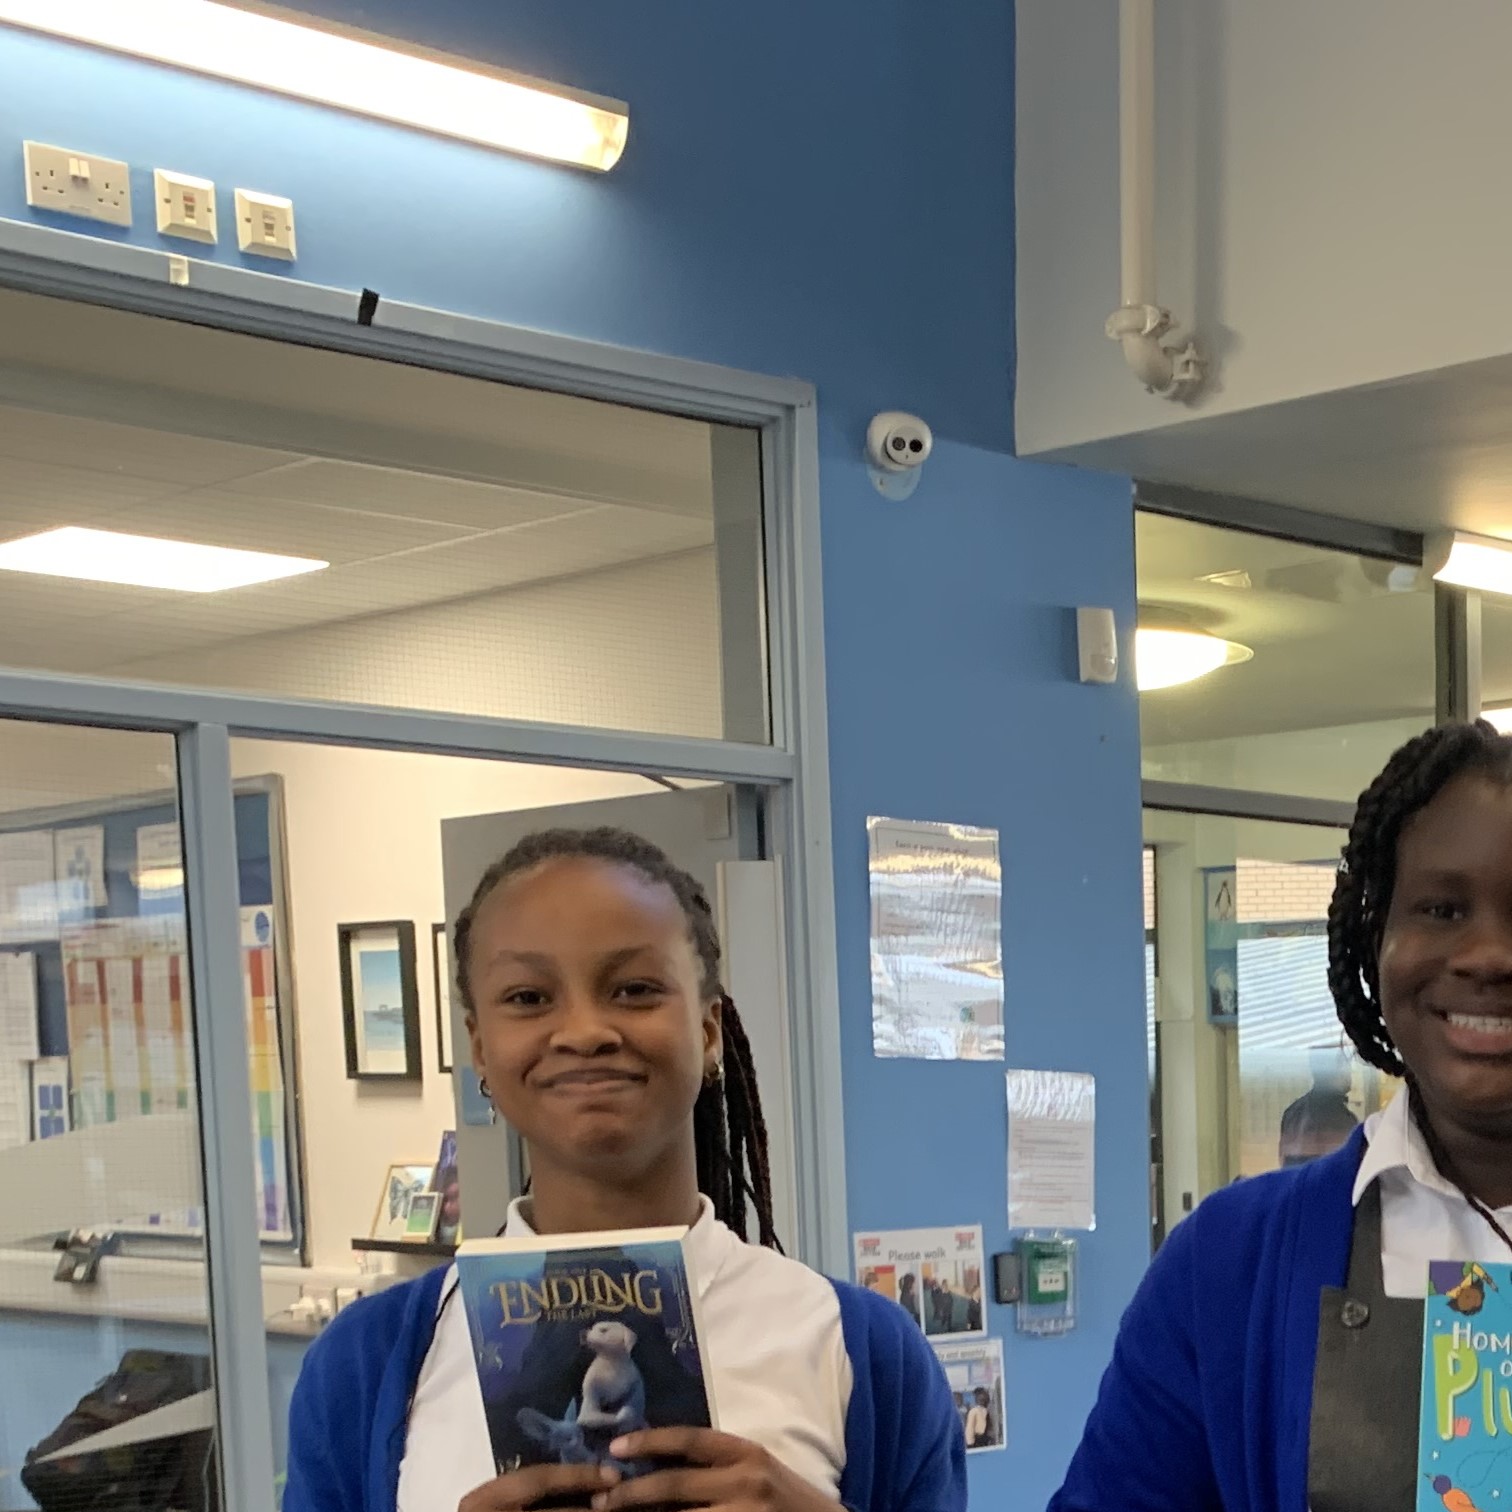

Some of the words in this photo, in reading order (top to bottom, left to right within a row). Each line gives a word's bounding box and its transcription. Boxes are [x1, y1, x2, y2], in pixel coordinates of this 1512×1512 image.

[888, 1249, 921, 1261] Please
[924, 1247, 946, 1258] walk
[489, 1268, 663, 1329] ENDLING
